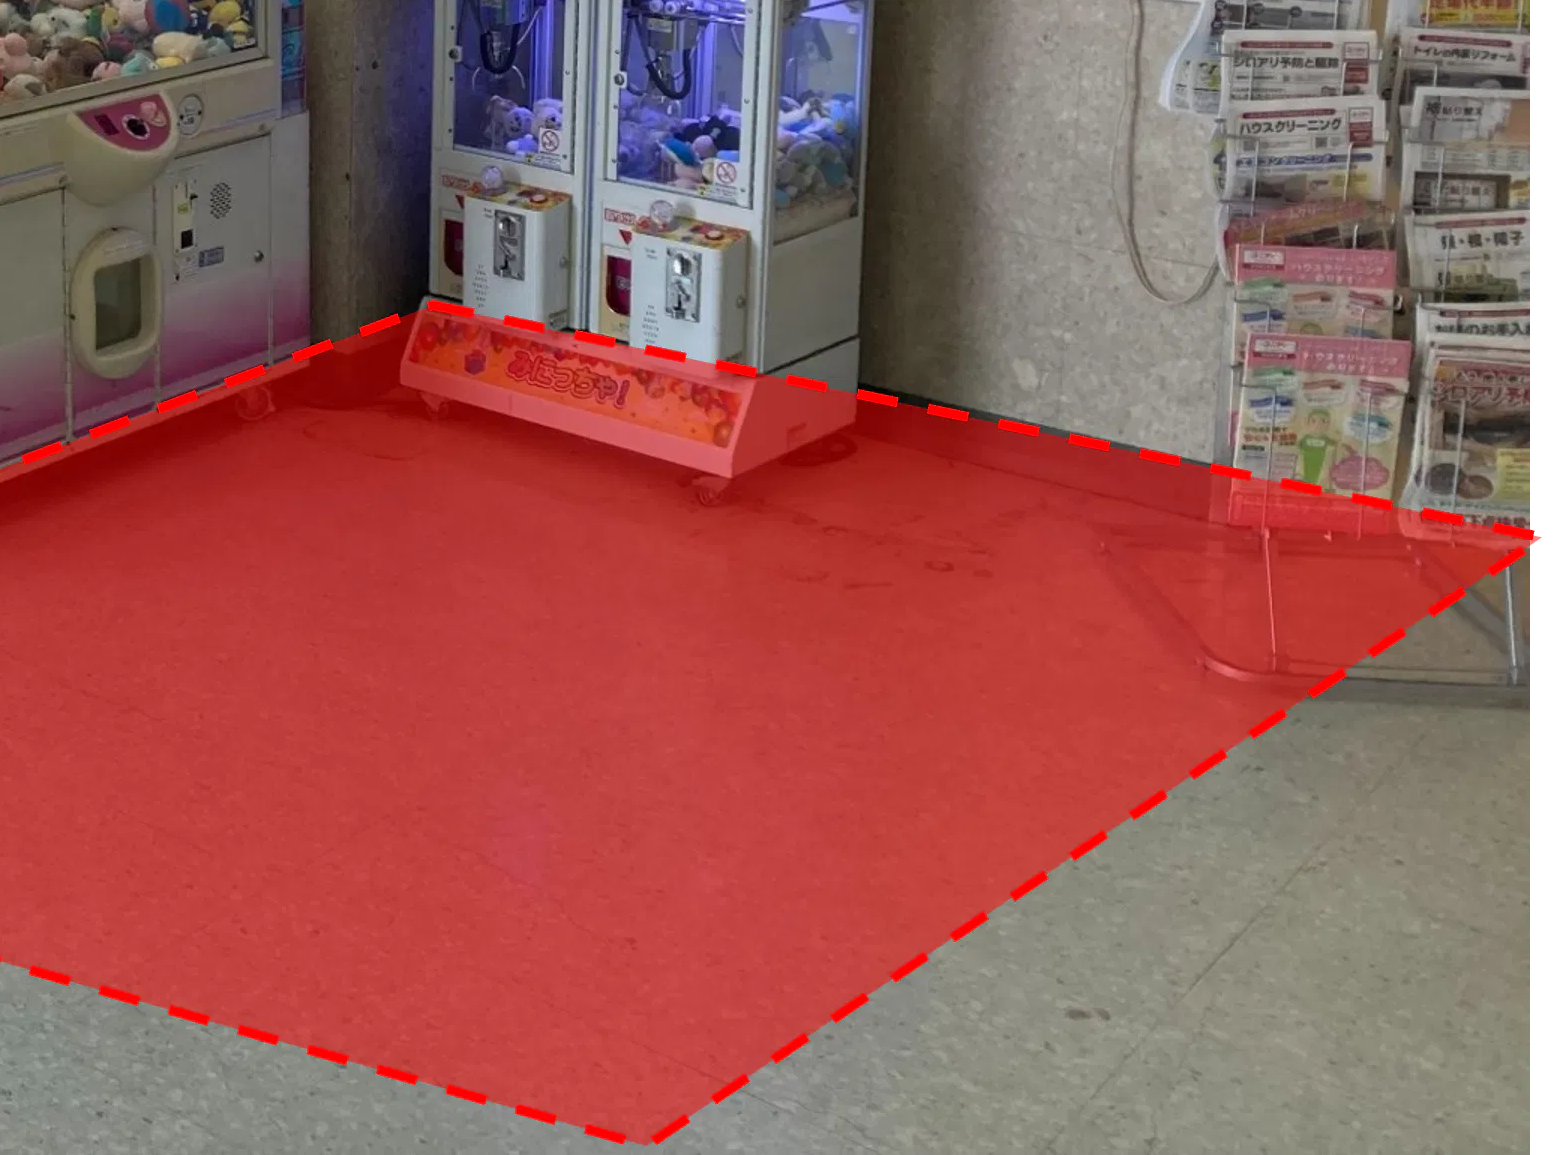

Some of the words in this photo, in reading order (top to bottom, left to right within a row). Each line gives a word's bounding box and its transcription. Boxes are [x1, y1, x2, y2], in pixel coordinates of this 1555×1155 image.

[1240, 118, 1342, 135] ハウスクリーニング
